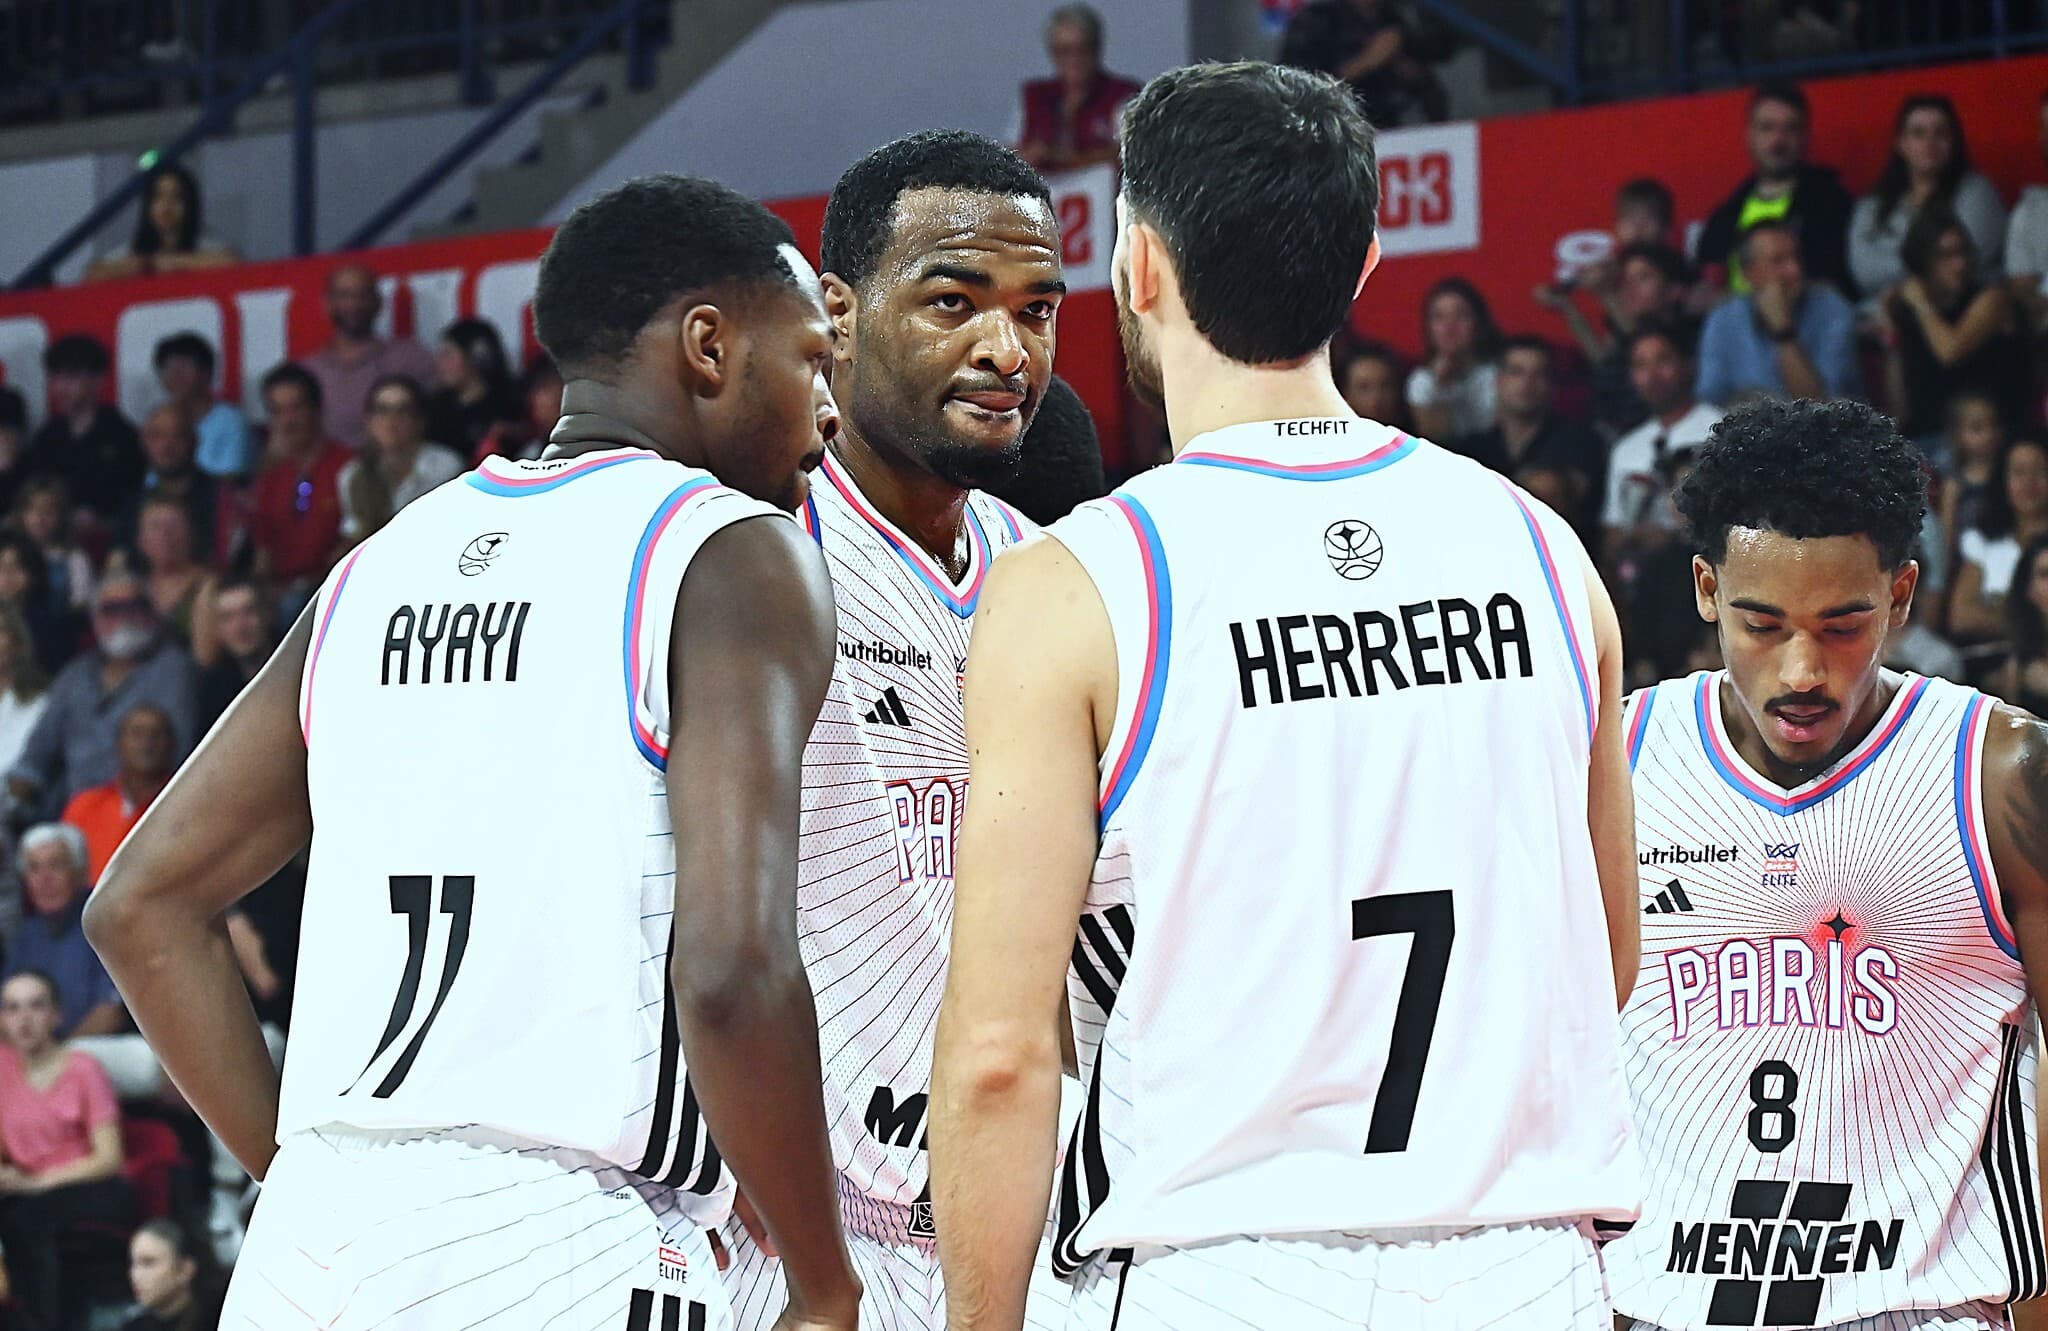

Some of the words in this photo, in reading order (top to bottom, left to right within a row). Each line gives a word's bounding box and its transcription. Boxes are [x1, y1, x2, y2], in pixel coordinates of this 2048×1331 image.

[1274, 421, 1349, 436] TECHFIT
[382, 602, 531, 685] AYAYI
[1229, 593, 1533, 708] HERRERA
[885, 777, 969, 884] PA
[1761, 873, 1798, 886] ELITE
[1352, 889, 1456, 1155] 7
[1665, 936, 1900, 1041] PARIS
[1747, 1060, 1799, 1153] 8
[659, 1262, 687, 1284] ELITE
[1666, 1219, 1904, 1276] MENNEN
